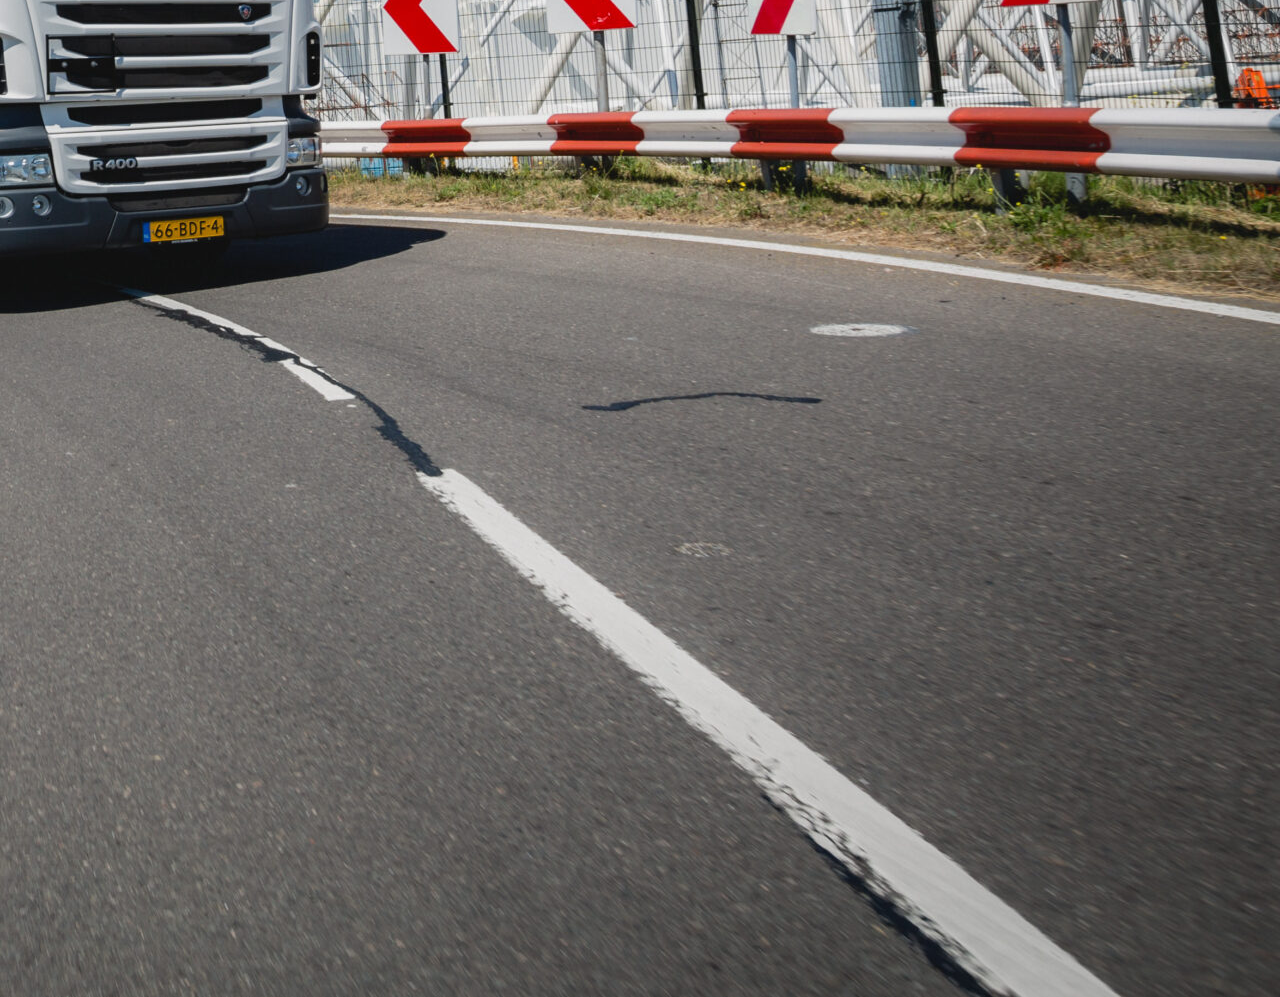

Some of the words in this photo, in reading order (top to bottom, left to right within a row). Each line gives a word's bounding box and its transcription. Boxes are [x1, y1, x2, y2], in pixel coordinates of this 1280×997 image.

[93, 160, 104, 171] R
[105, 157, 137, 170] 400
[154, 219, 220, 239] 66-BDF-4
